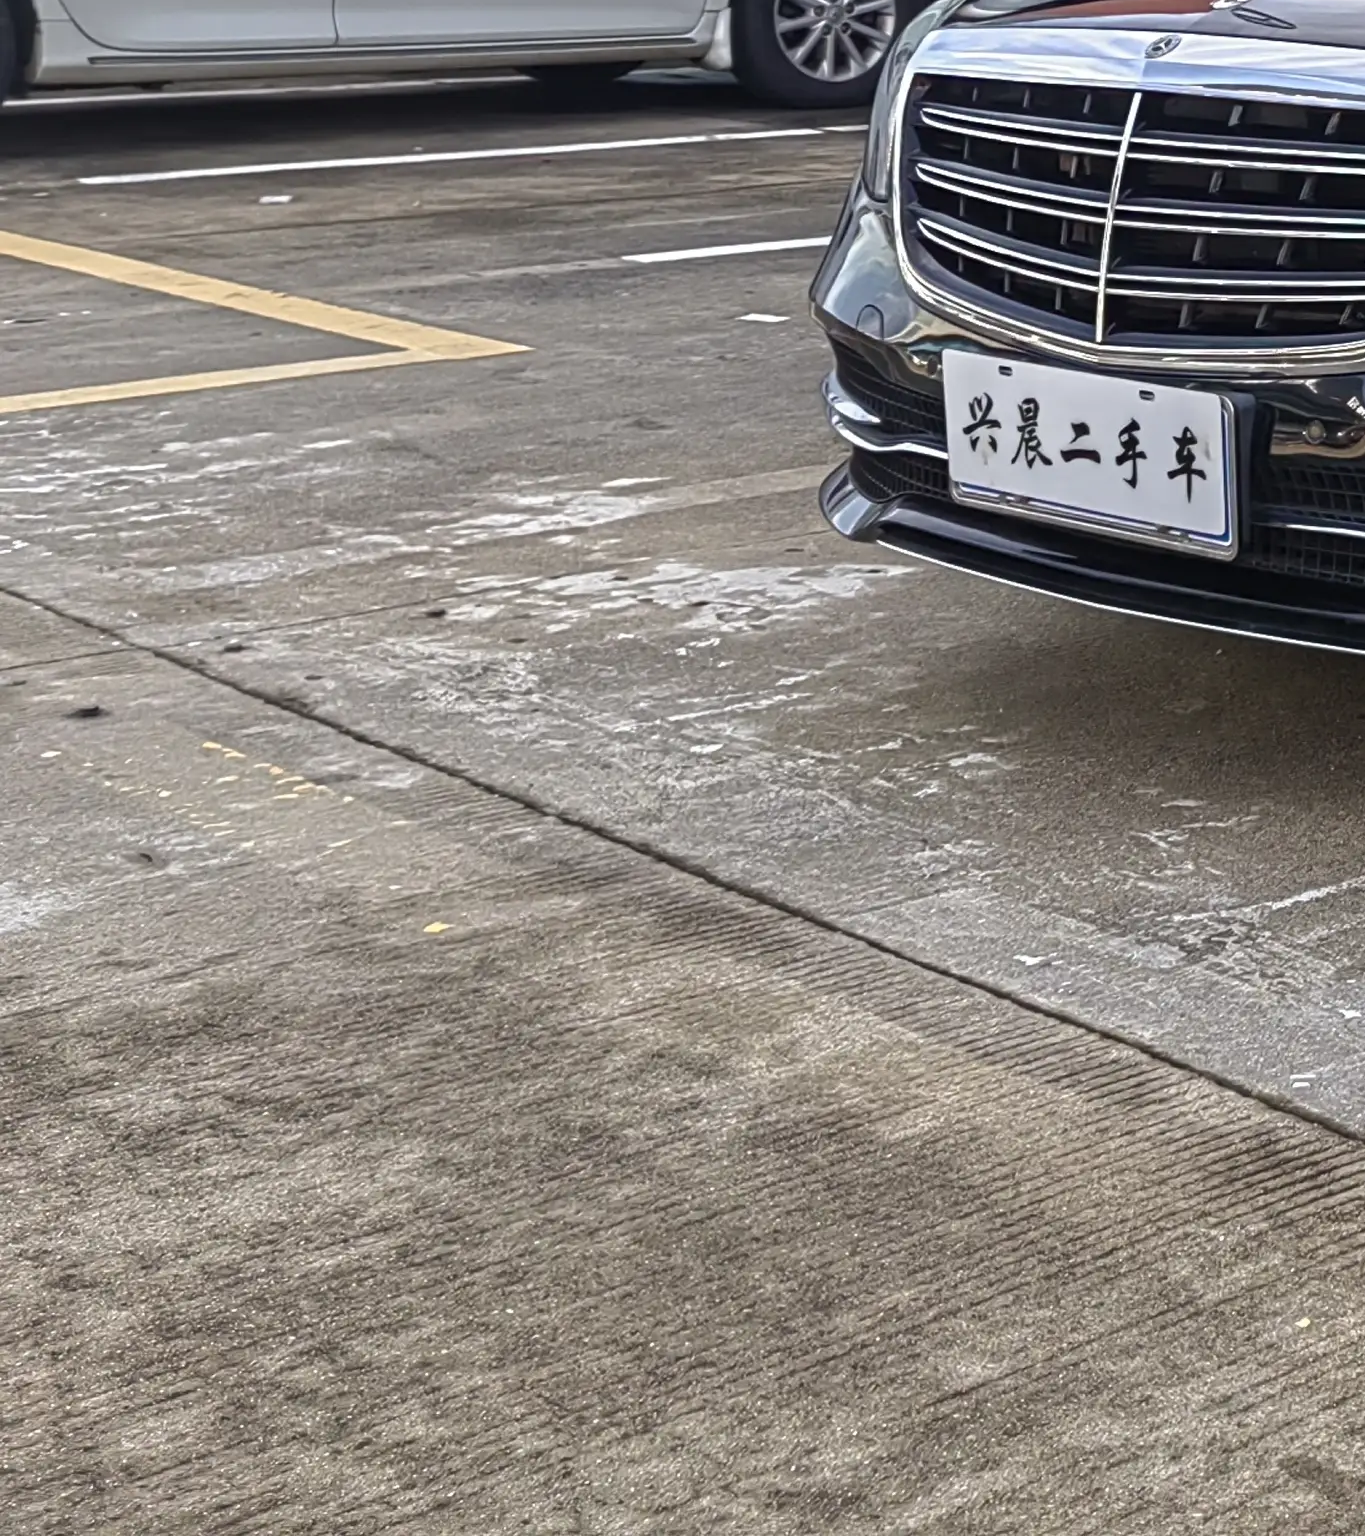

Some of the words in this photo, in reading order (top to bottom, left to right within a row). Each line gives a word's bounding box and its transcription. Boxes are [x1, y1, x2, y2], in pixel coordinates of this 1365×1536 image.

[962, 392, 1208, 504] 兴晨二手车
